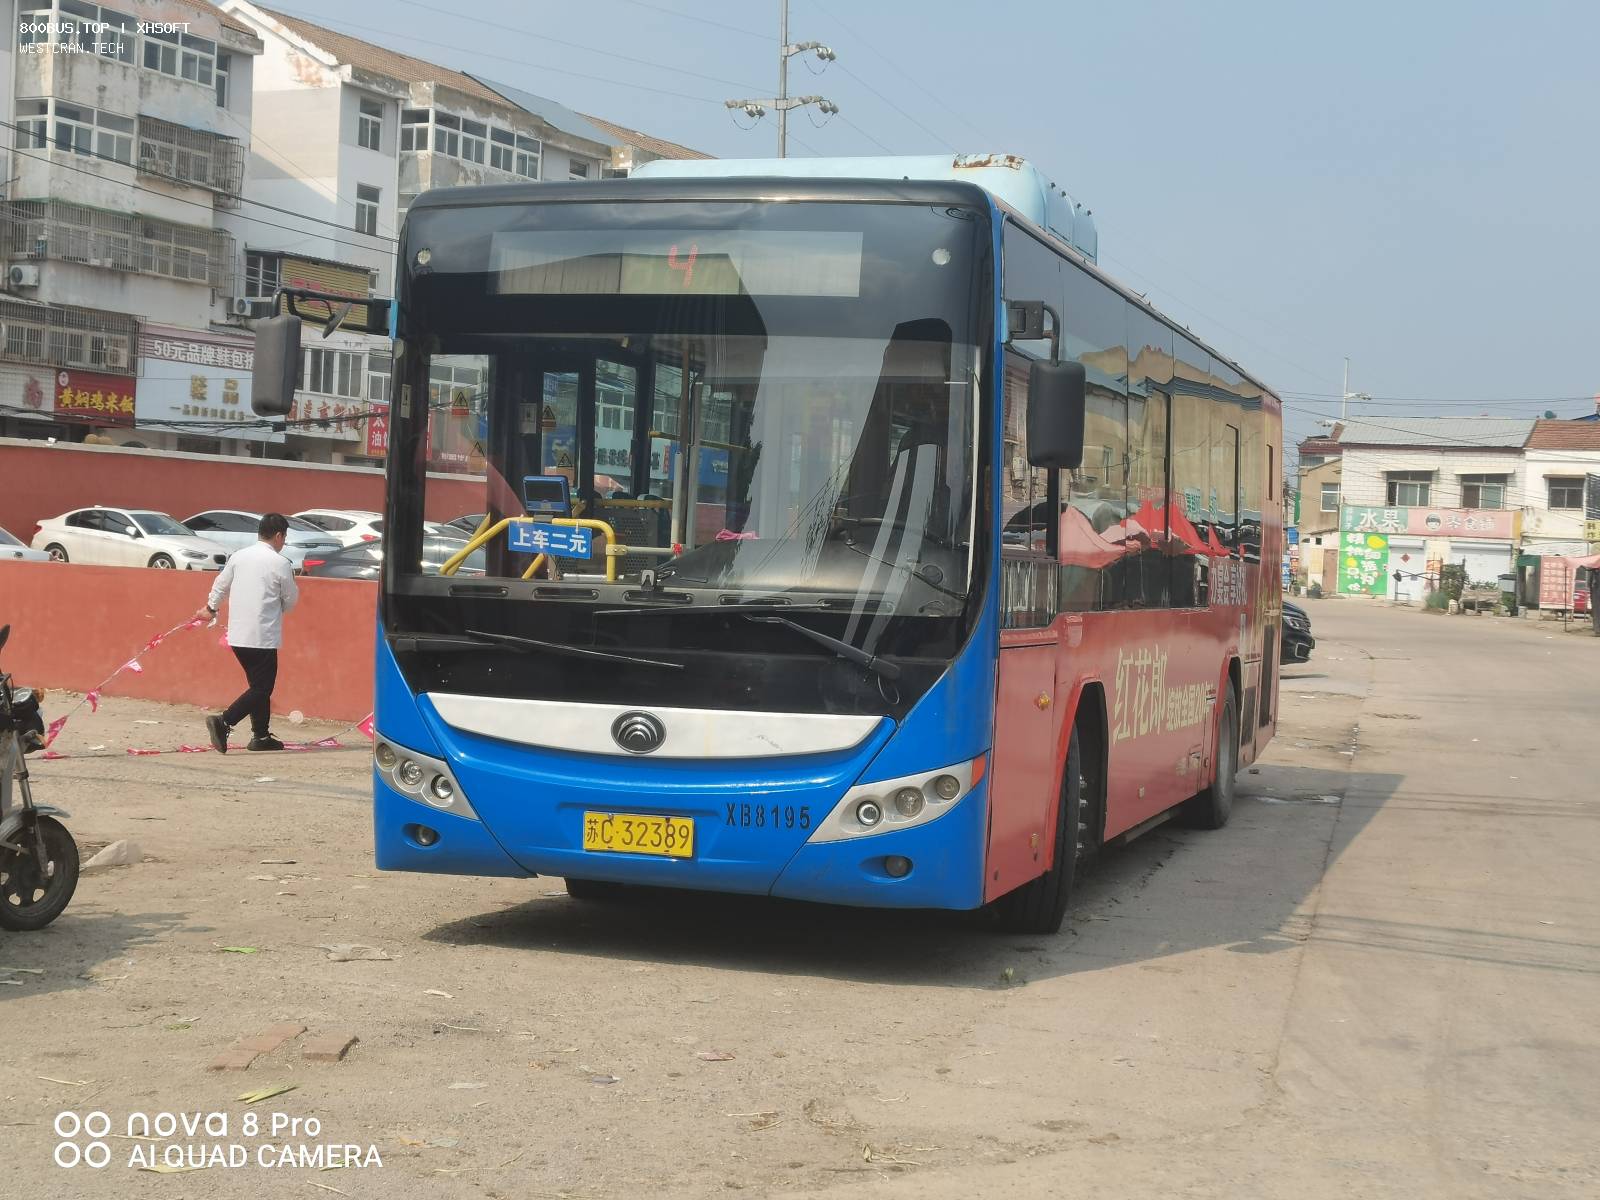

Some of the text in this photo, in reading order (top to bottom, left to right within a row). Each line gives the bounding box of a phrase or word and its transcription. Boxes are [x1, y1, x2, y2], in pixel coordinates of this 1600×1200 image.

[669, 245, 698, 287] 4
[58, 386, 134, 414] 黄焖鸡米饭
[1360, 508, 1400, 529] 水果
[513, 527, 587, 553] 上车二元
[1113, 643, 1167, 744] 红花郎
[726, 803, 811, 829] XB8195
